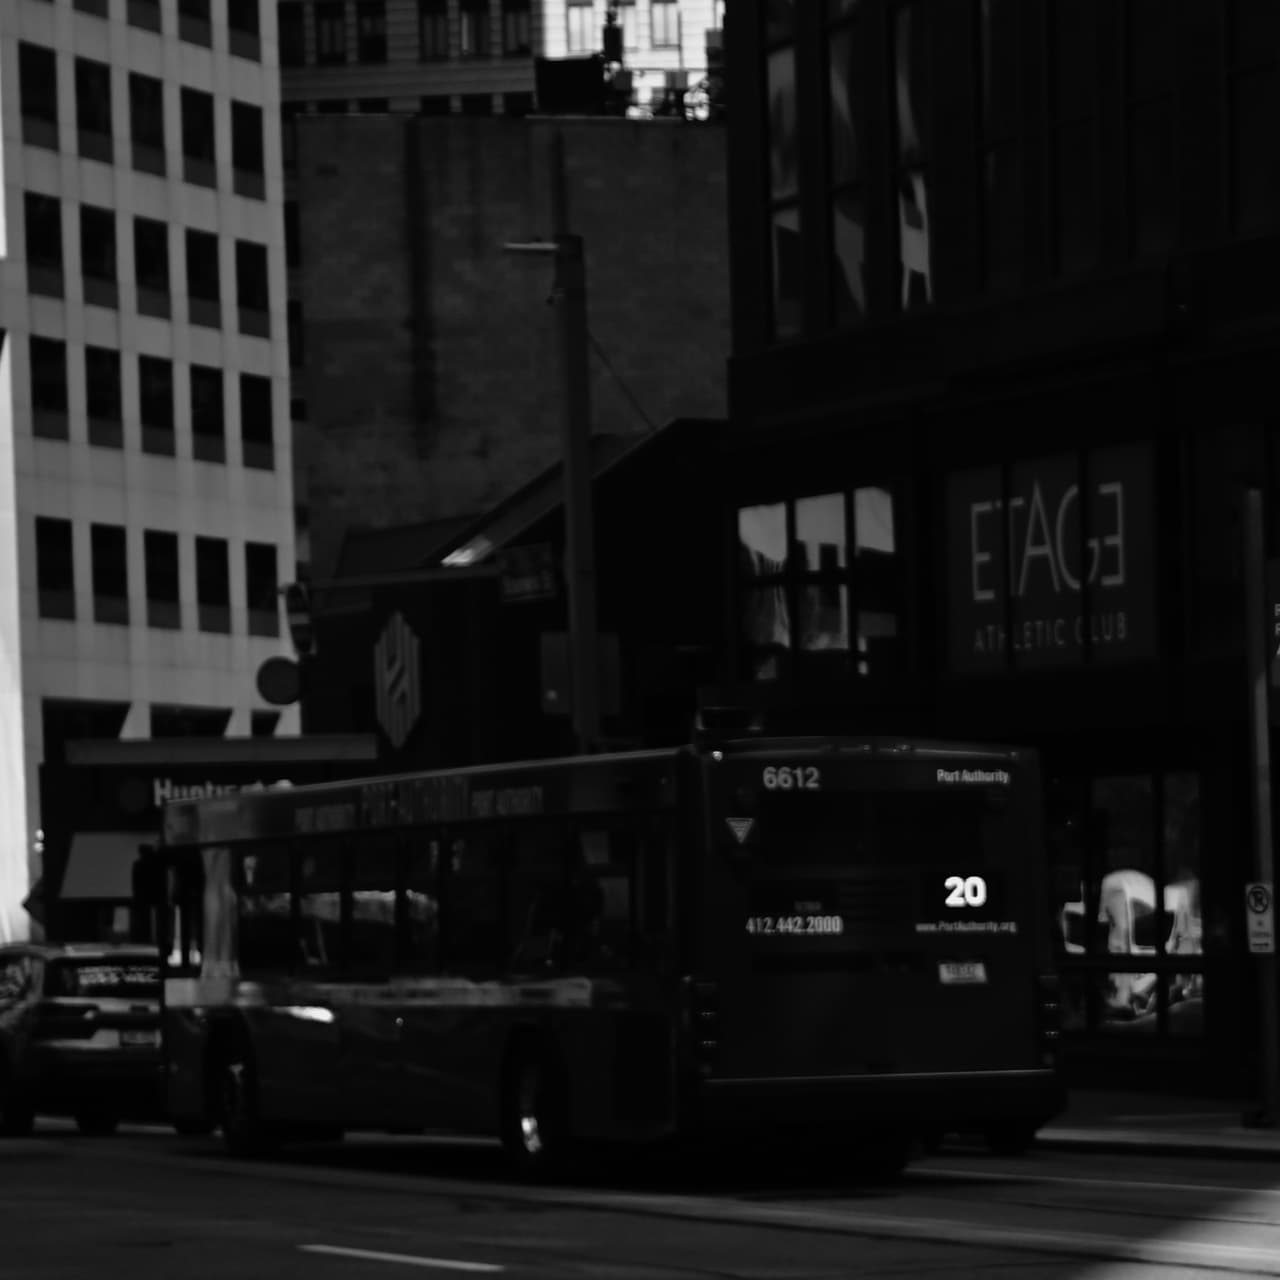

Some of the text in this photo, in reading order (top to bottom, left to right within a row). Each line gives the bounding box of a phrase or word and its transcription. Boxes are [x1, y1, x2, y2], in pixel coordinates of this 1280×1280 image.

[1074, 608, 1128, 646] CLUB
[762, 766, 820, 790] 6612
[936, 768, 1011, 787] Port Authority
[943, 875, 988, 908] 20
[745, 915, 844, 935] 412.442.2000
